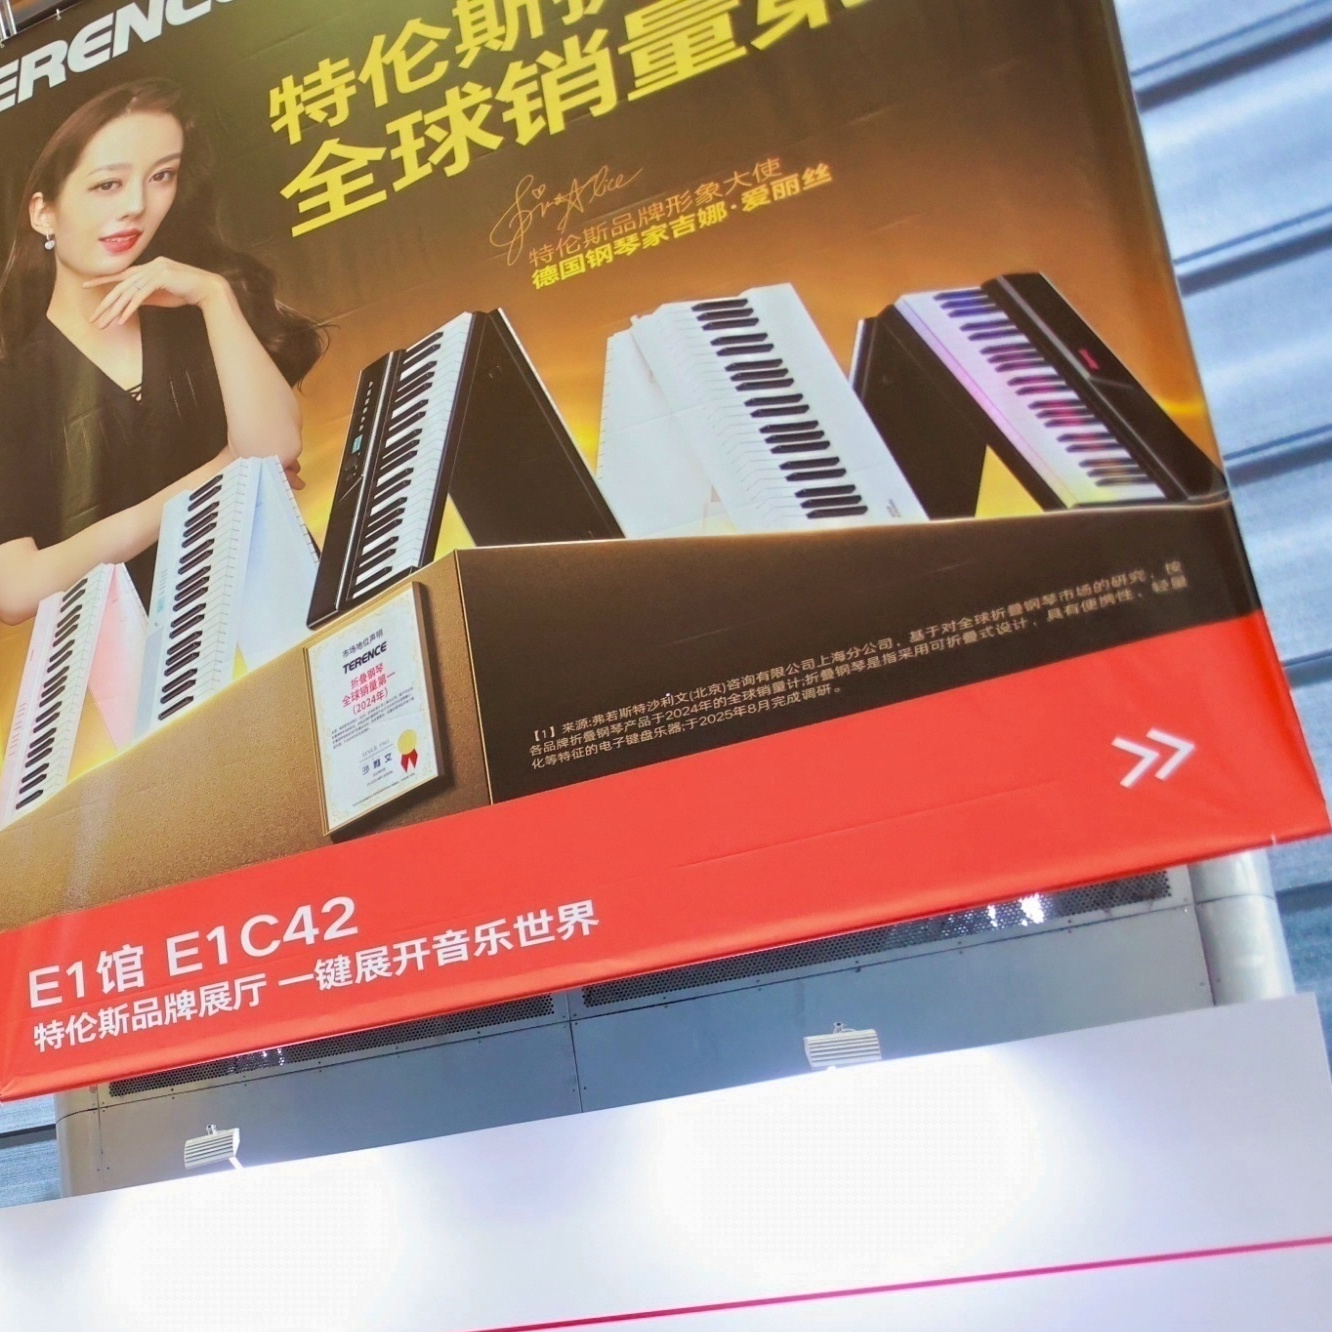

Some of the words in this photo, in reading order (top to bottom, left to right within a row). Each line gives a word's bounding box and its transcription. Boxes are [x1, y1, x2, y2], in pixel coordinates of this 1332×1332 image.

[529, 157, 782, 267] 特伦斯品牌形象大使
[343, 641, 387, 674] TERENCE
[28, 942, 145, 1009] E1馆
[165, 895, 360, 976] E1C42
[32, 973, 268, 1053] 特伦斯品牌展厅
[278, 899, 600, 994] 一键展开音乐世界
